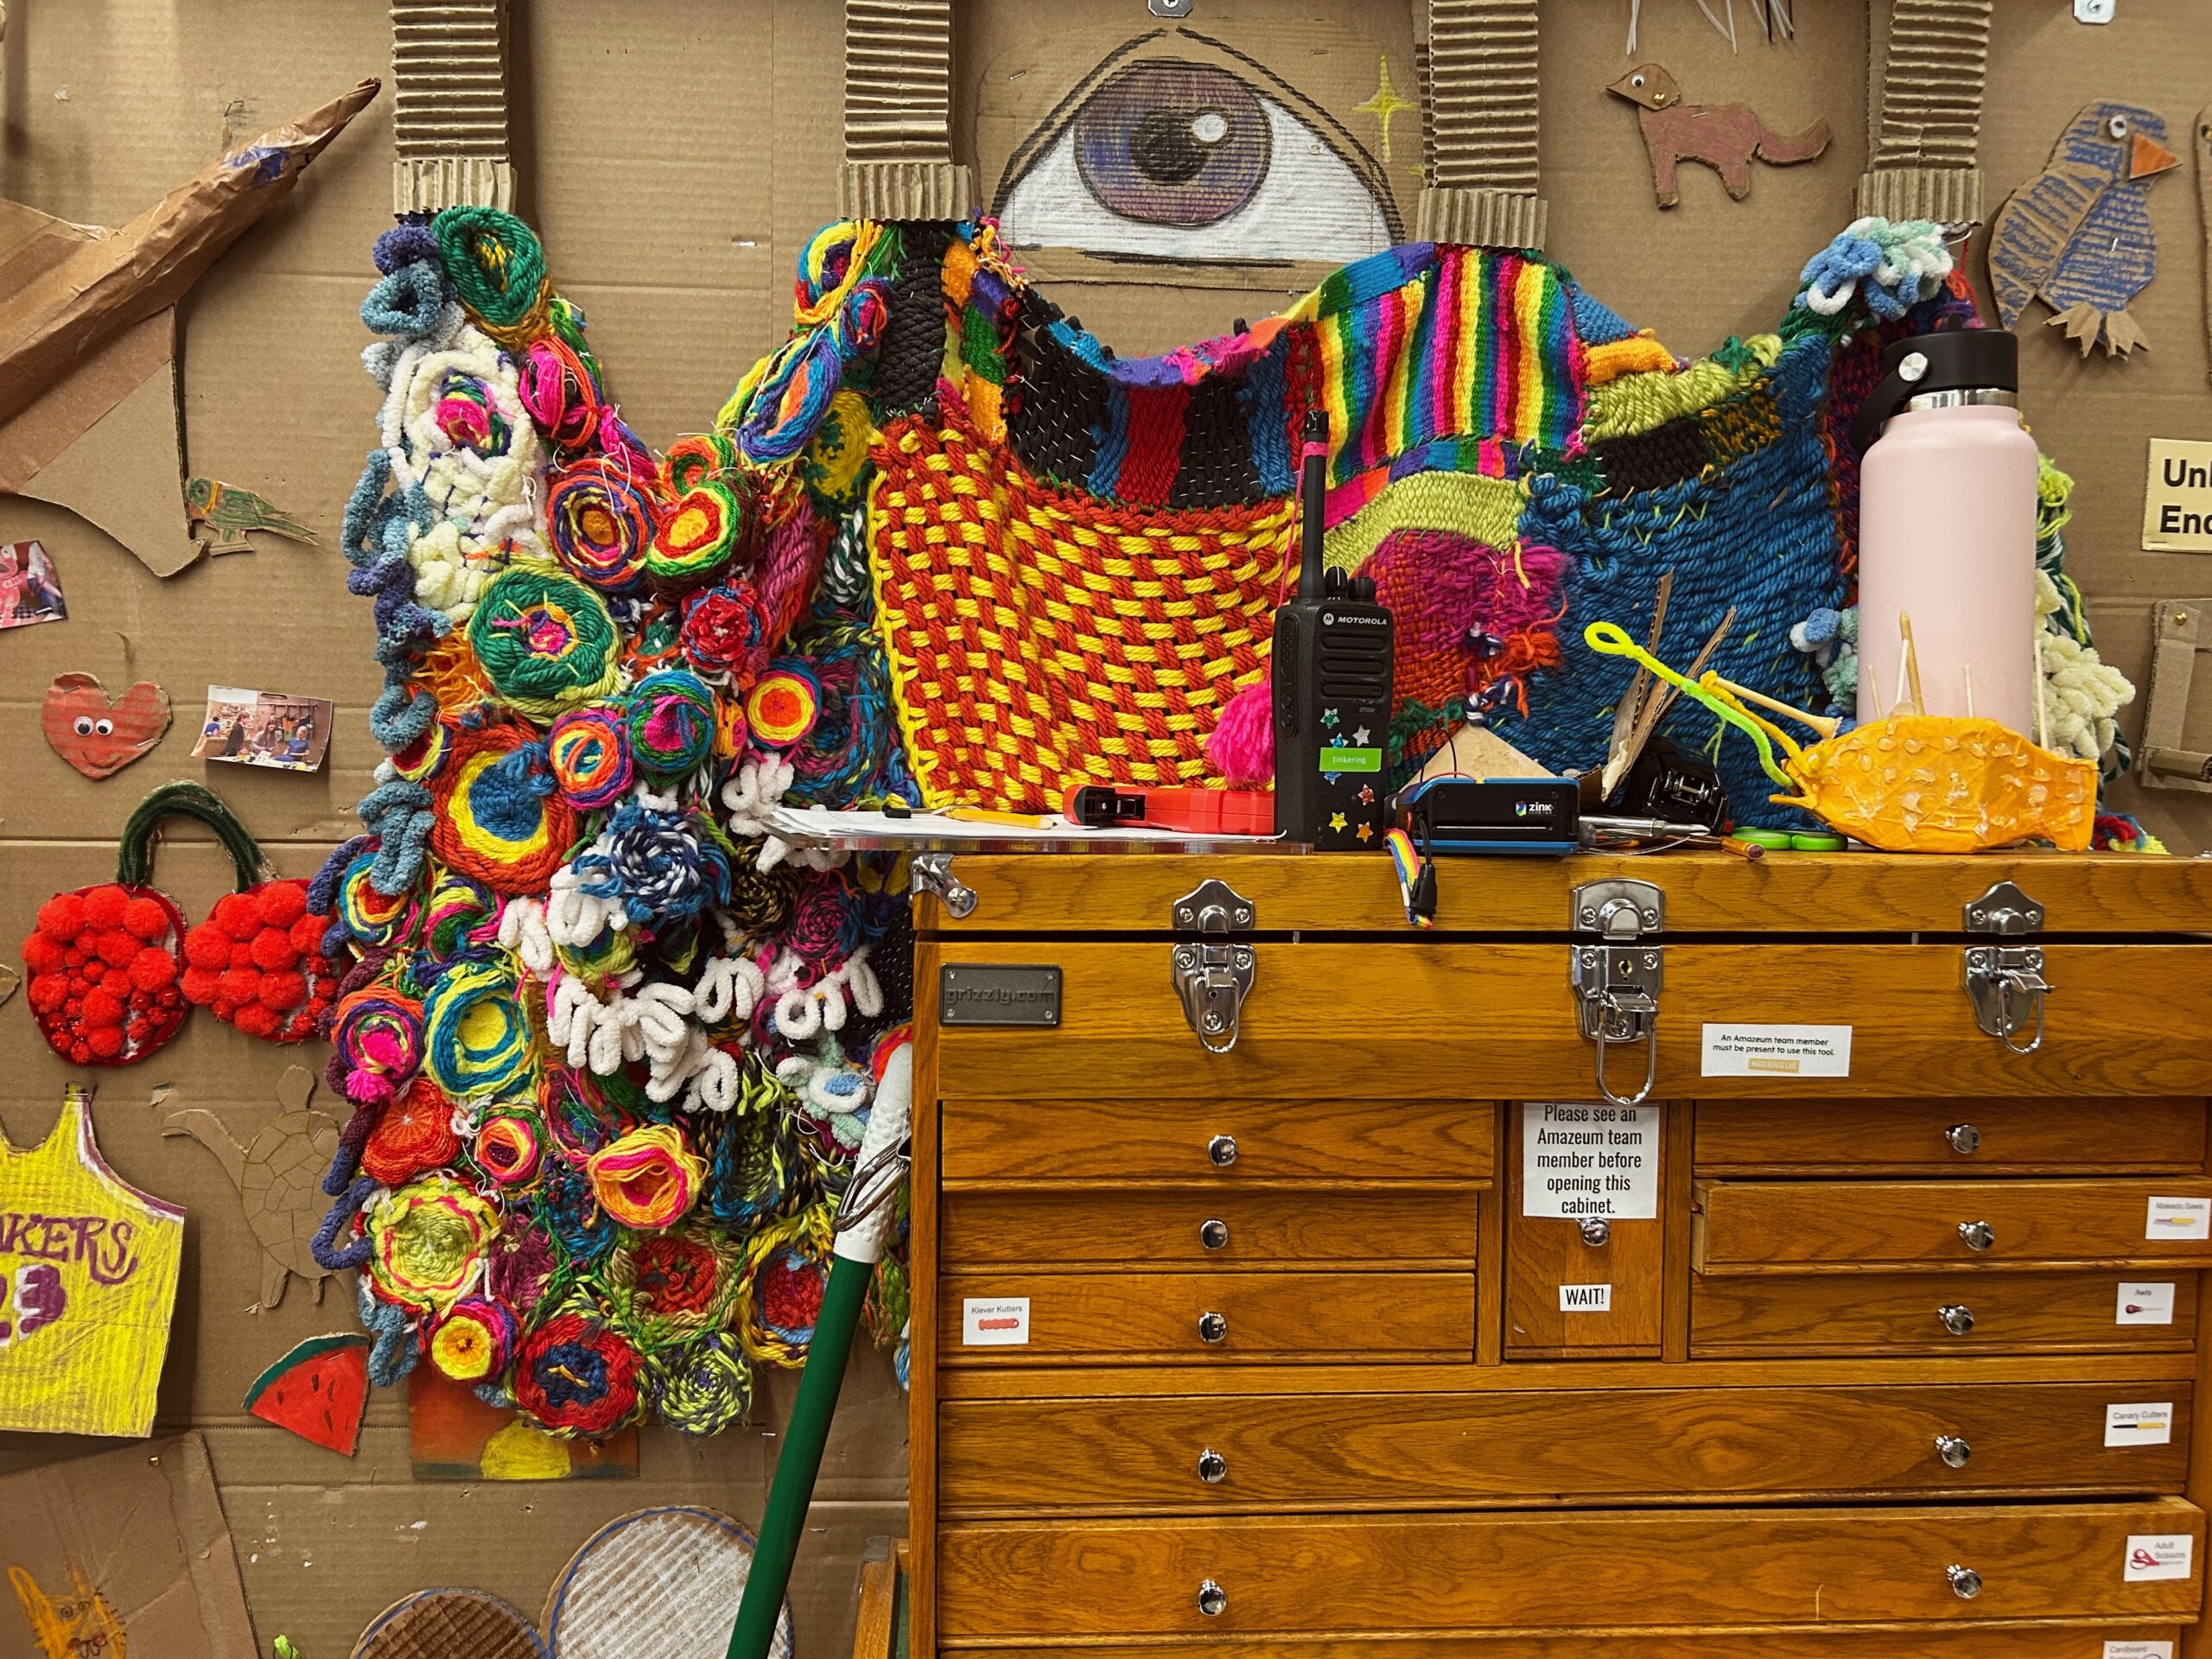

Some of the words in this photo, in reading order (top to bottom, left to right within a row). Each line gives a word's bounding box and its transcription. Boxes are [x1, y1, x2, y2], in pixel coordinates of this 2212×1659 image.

[1338, 616, 1387, 626] MOTOROLA
[1332, 755, 1367, 765] tinkering
[1529, 802, 1553, 811] zink
[946, 986, 1054, 1005] grizzly.com
[1733, 1035, 1772, 1044] Amazeum
[1802, 1046, 1816, 1055] this
[1751, 1059, 1784, 1070] MATERIALS
[1544, 1105, 1589, 1122] Please
[1593, 1109, 1616, 1122] see
[1620, 1109, 1637, 1122] an
[1537, 1128, 1604, 1145] Amazeum
[1608, 1129, 1642, 1145] team
[1537, 1152, 1594, 1167] member
[1599, 1152, 1642, 1168] before
[1547, 1175, 1601, 1194] opening
[1605, 1174, 1631, 1191] this
[1561, 1198, 1616, 1214] cabinet.
[1566, 1288, 1605, 1306] WAIT!
